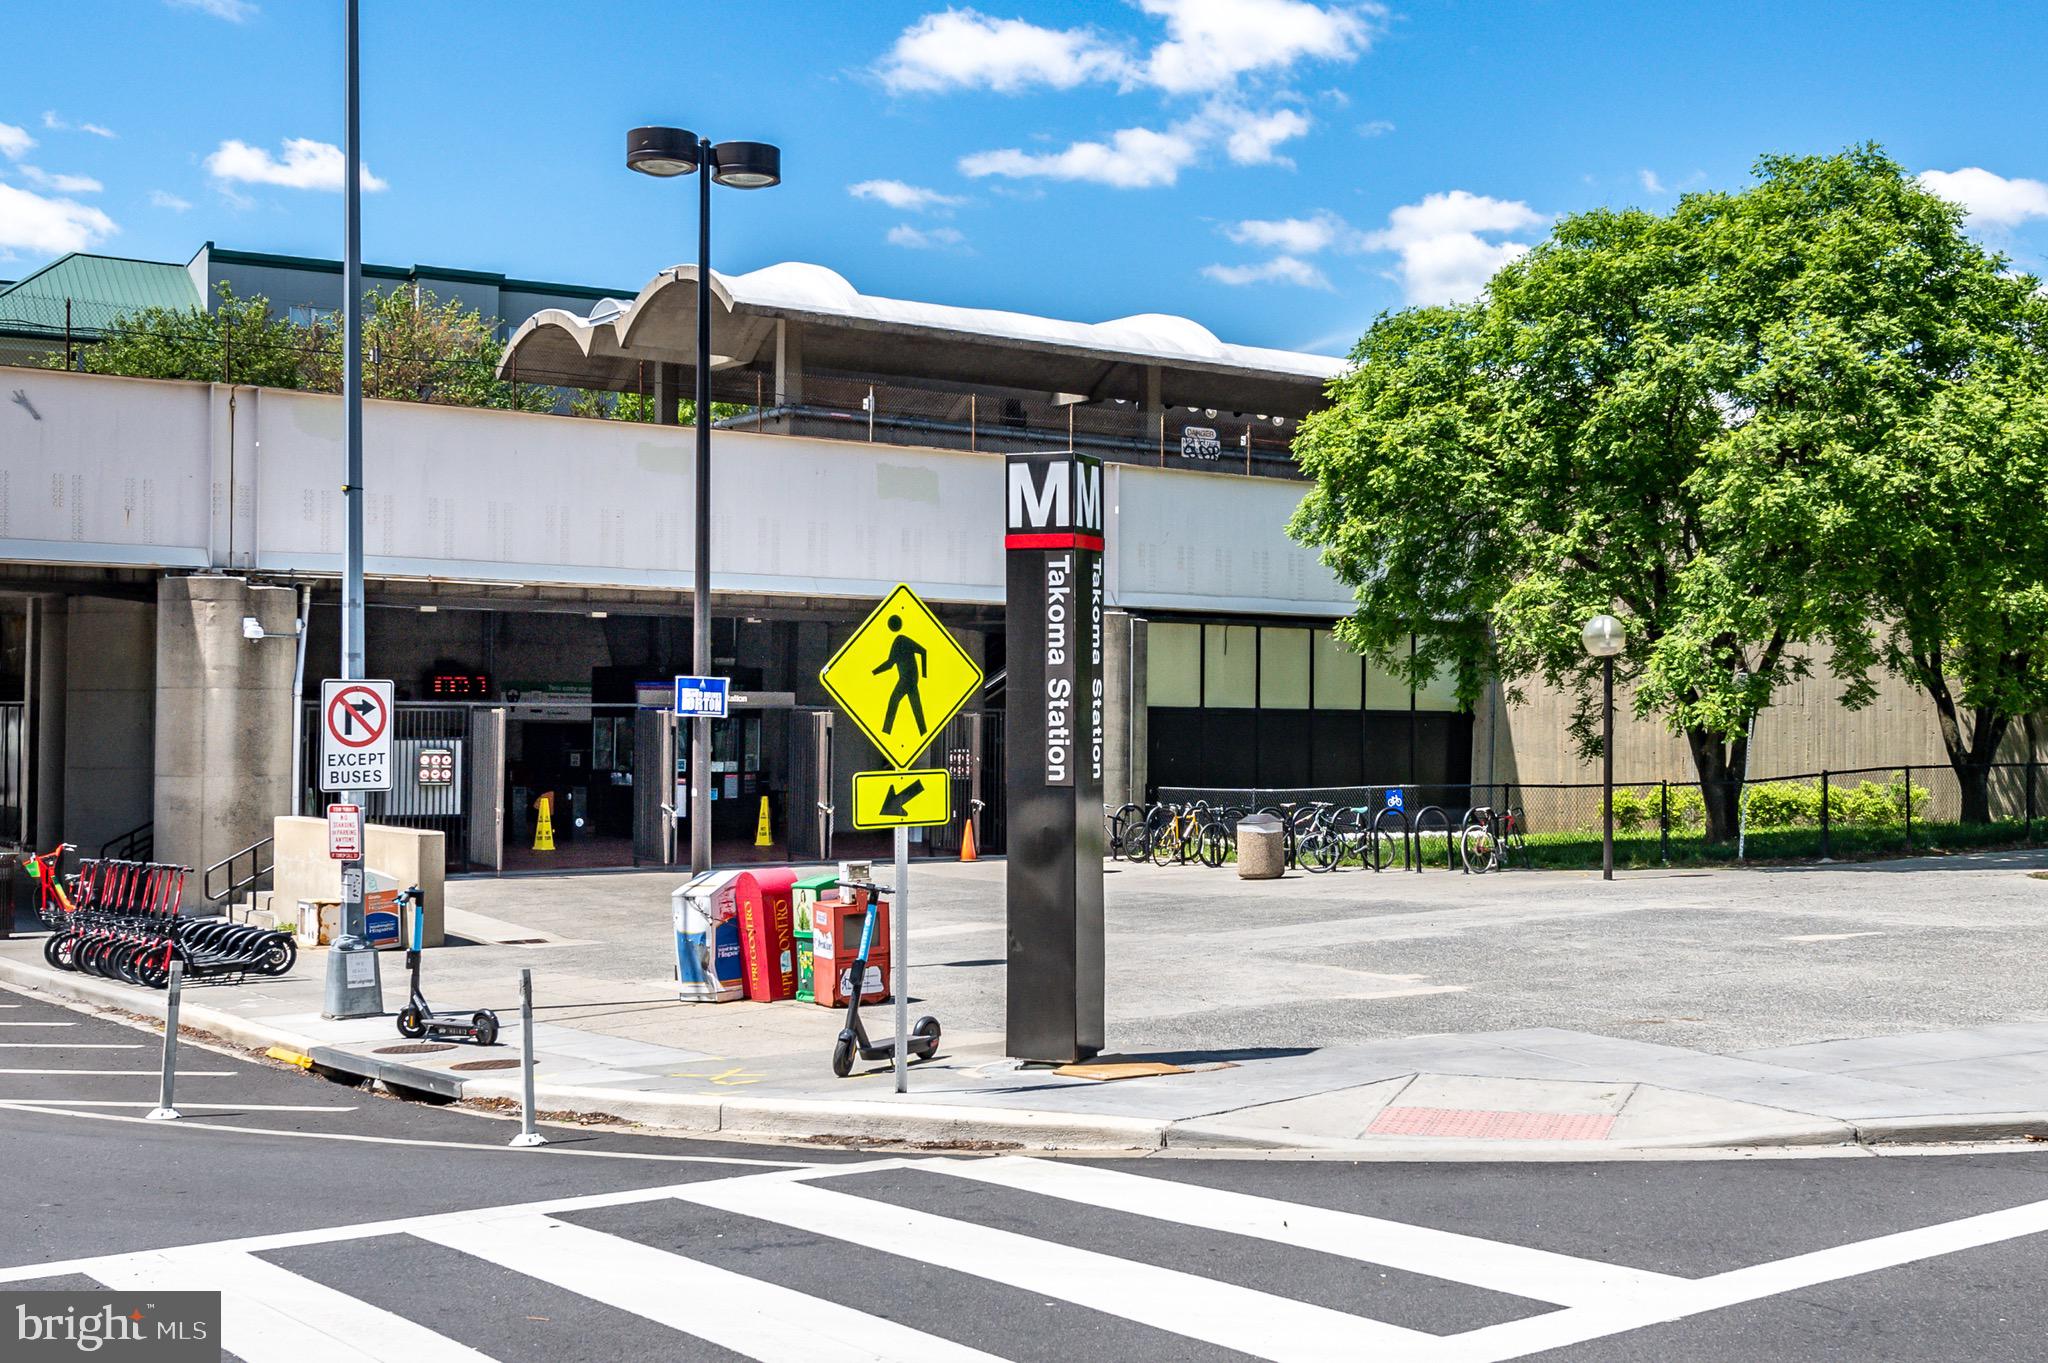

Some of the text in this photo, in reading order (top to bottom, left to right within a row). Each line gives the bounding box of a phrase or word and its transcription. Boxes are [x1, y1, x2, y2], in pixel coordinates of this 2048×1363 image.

[1187, 428, 1215, 438] DANGER
[1009, 462, 1070, 528] M
[1076, 462, 1100, 530] M
[1047, 554, 1071, 781] Takoma Station
[1092, 558, 1102, 779] Takoma Station
[728, 694, 748, 702] tation
[328, 752, 386, 766] EXCEPT
[330, 770, 382, 784] BUSES
